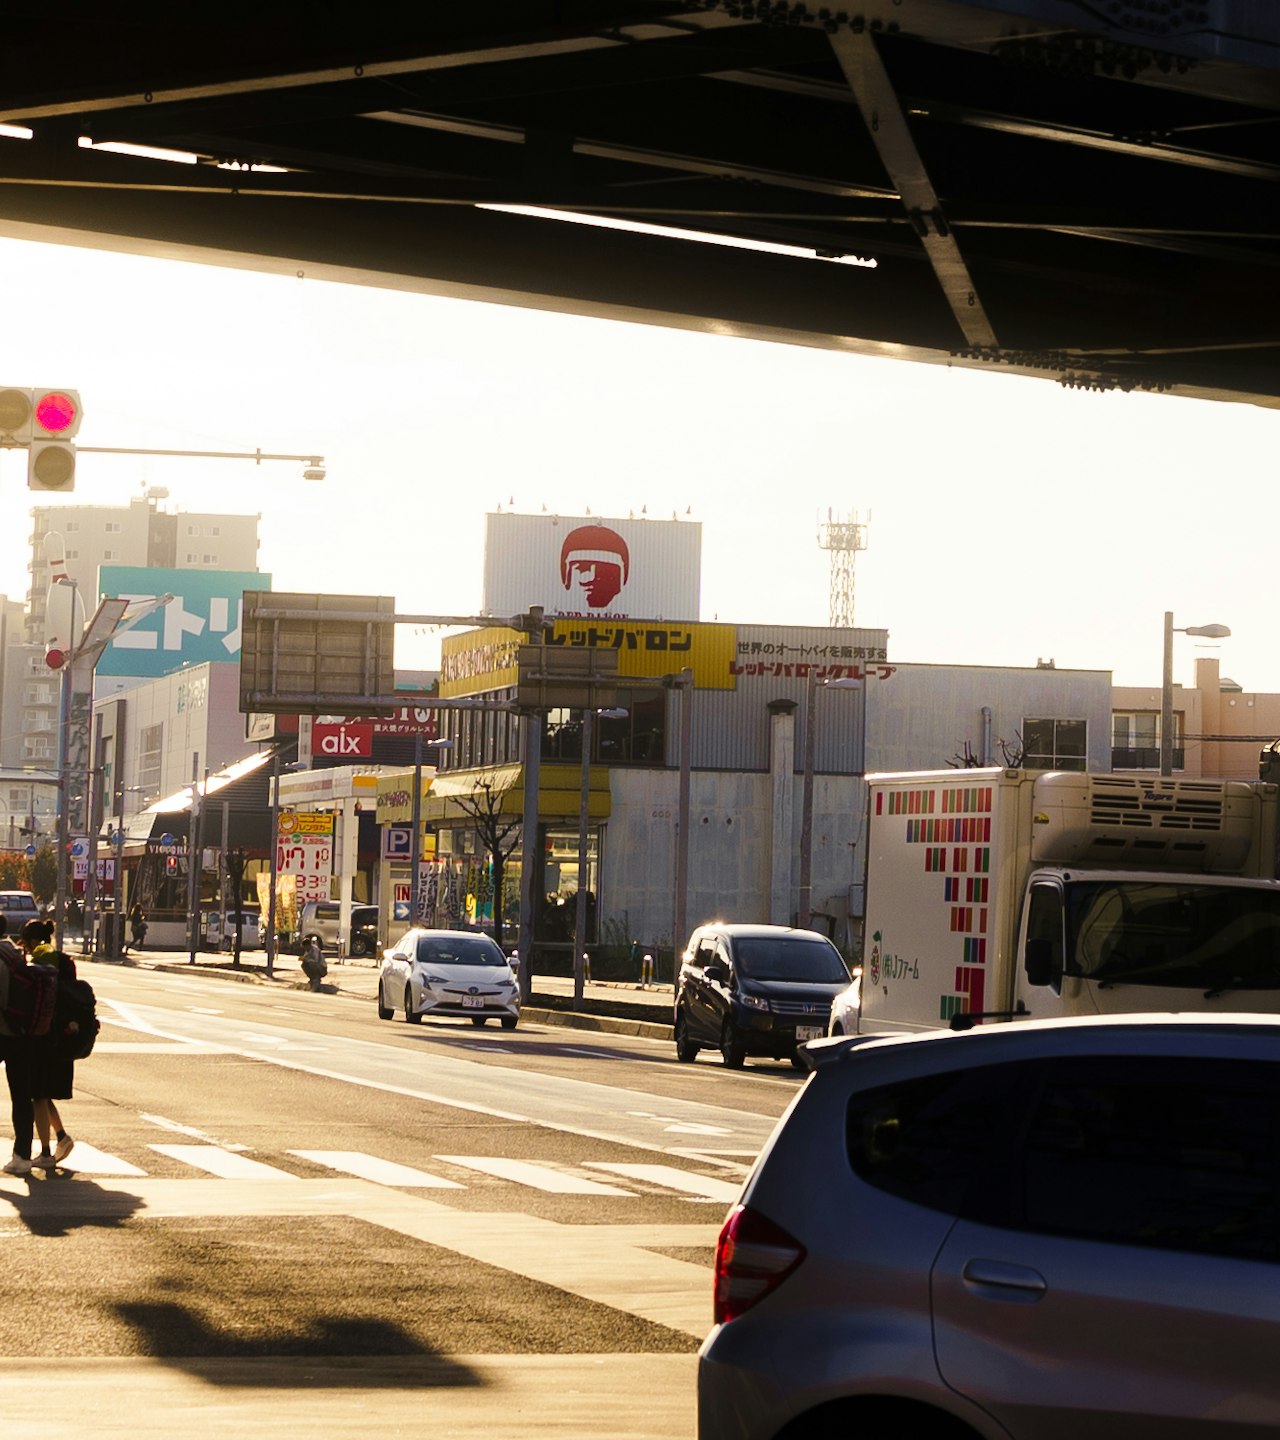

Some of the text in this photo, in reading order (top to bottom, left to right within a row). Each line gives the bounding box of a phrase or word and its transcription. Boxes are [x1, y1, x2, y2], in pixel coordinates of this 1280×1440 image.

[113, 594, 242, 655] ニトリ
[544, 627, 692, 651] レッドバロン
[738, 642, 887, 659] 世界のオートバイを販売する
[729, 661, 897, 680] レッドバロングループ
[322, 727, 361, 754] aix
[1143, 790, 1173, 801] Topre
[390, 831, 408, 852] P
[396, 886, 410, 901] IN
